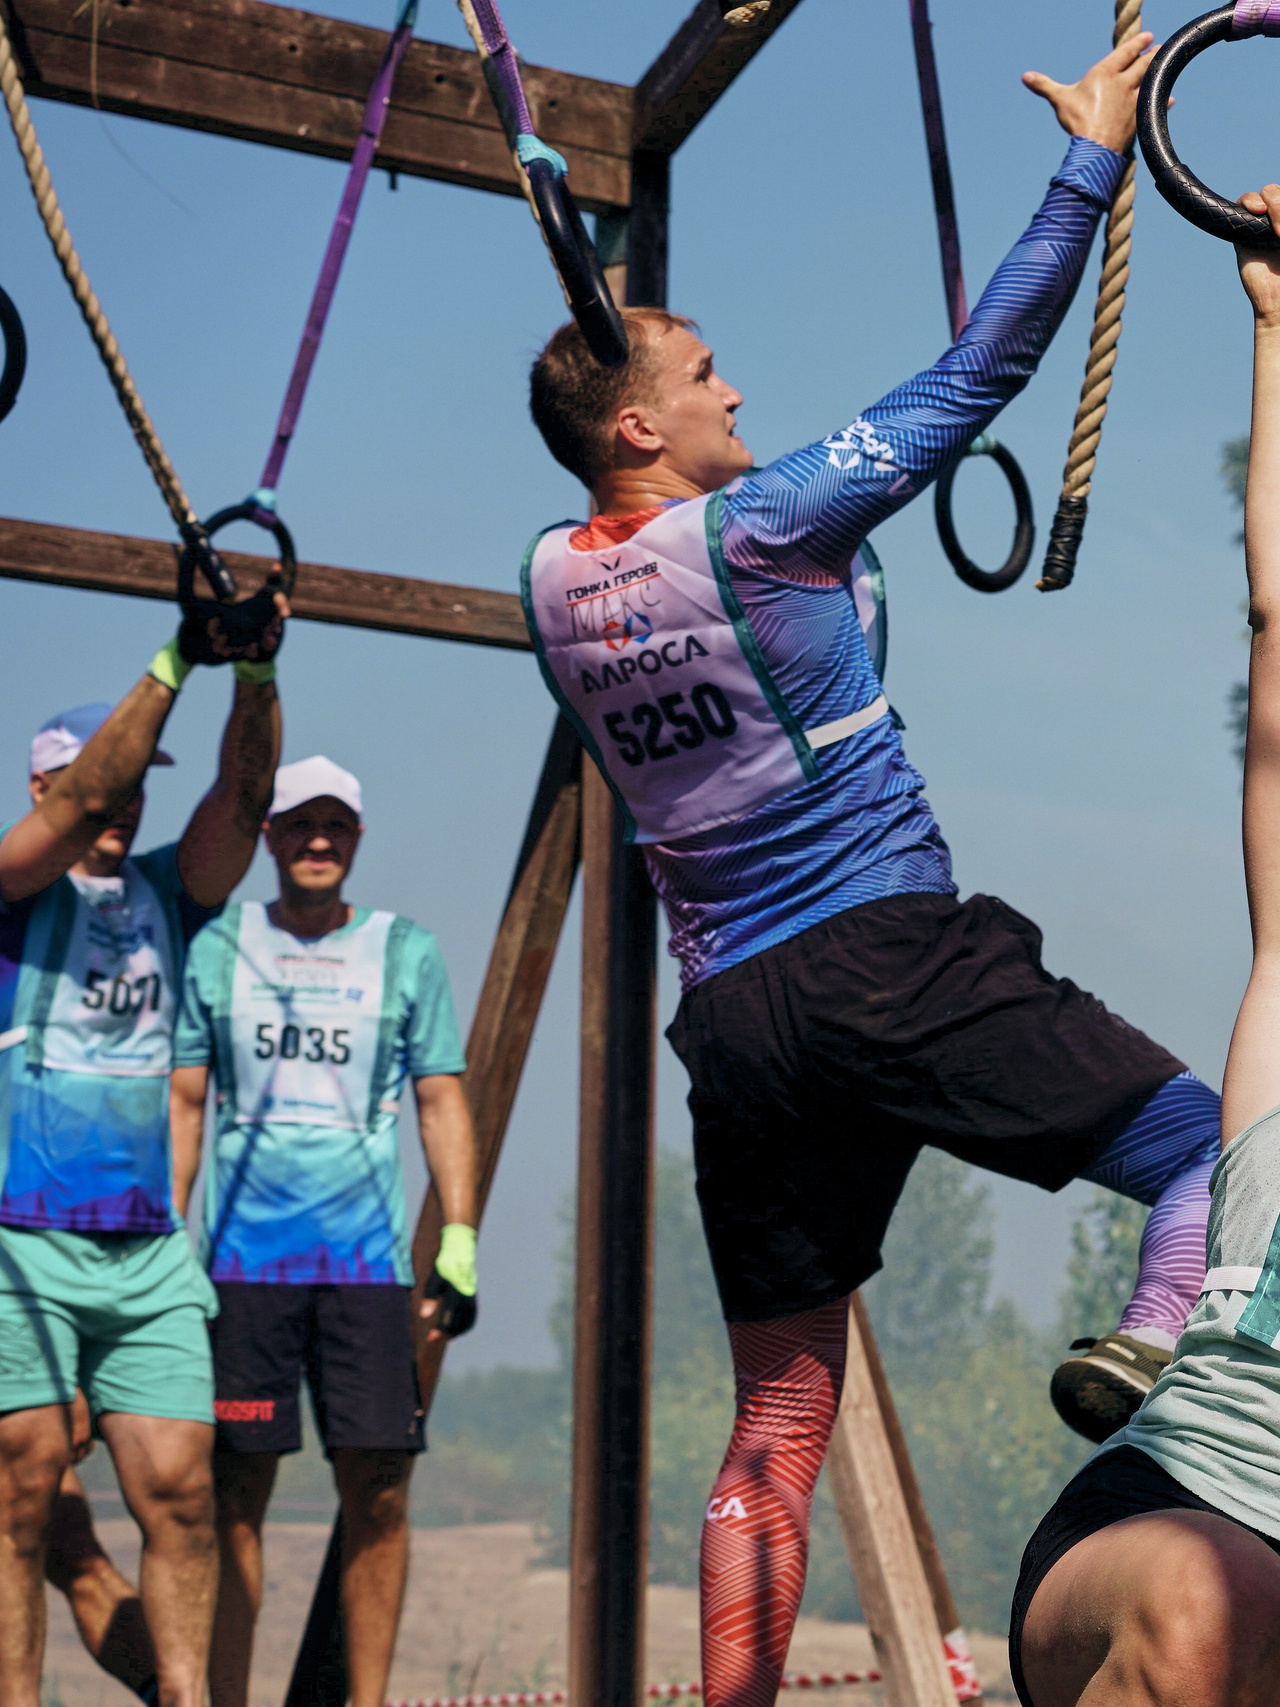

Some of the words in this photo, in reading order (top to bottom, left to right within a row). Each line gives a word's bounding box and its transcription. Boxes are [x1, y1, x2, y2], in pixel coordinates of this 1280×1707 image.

[566, 580, 611, 601] ГОНКА
[614, 562, 658, 587] ГЕРОЕВ
[571, 582, 661, 639] МАКС
[581, 635, 710, 694] АЛРОСА
[603, 682, 738, 767] 5250
[255, 1024, 351, 1065] 5035
